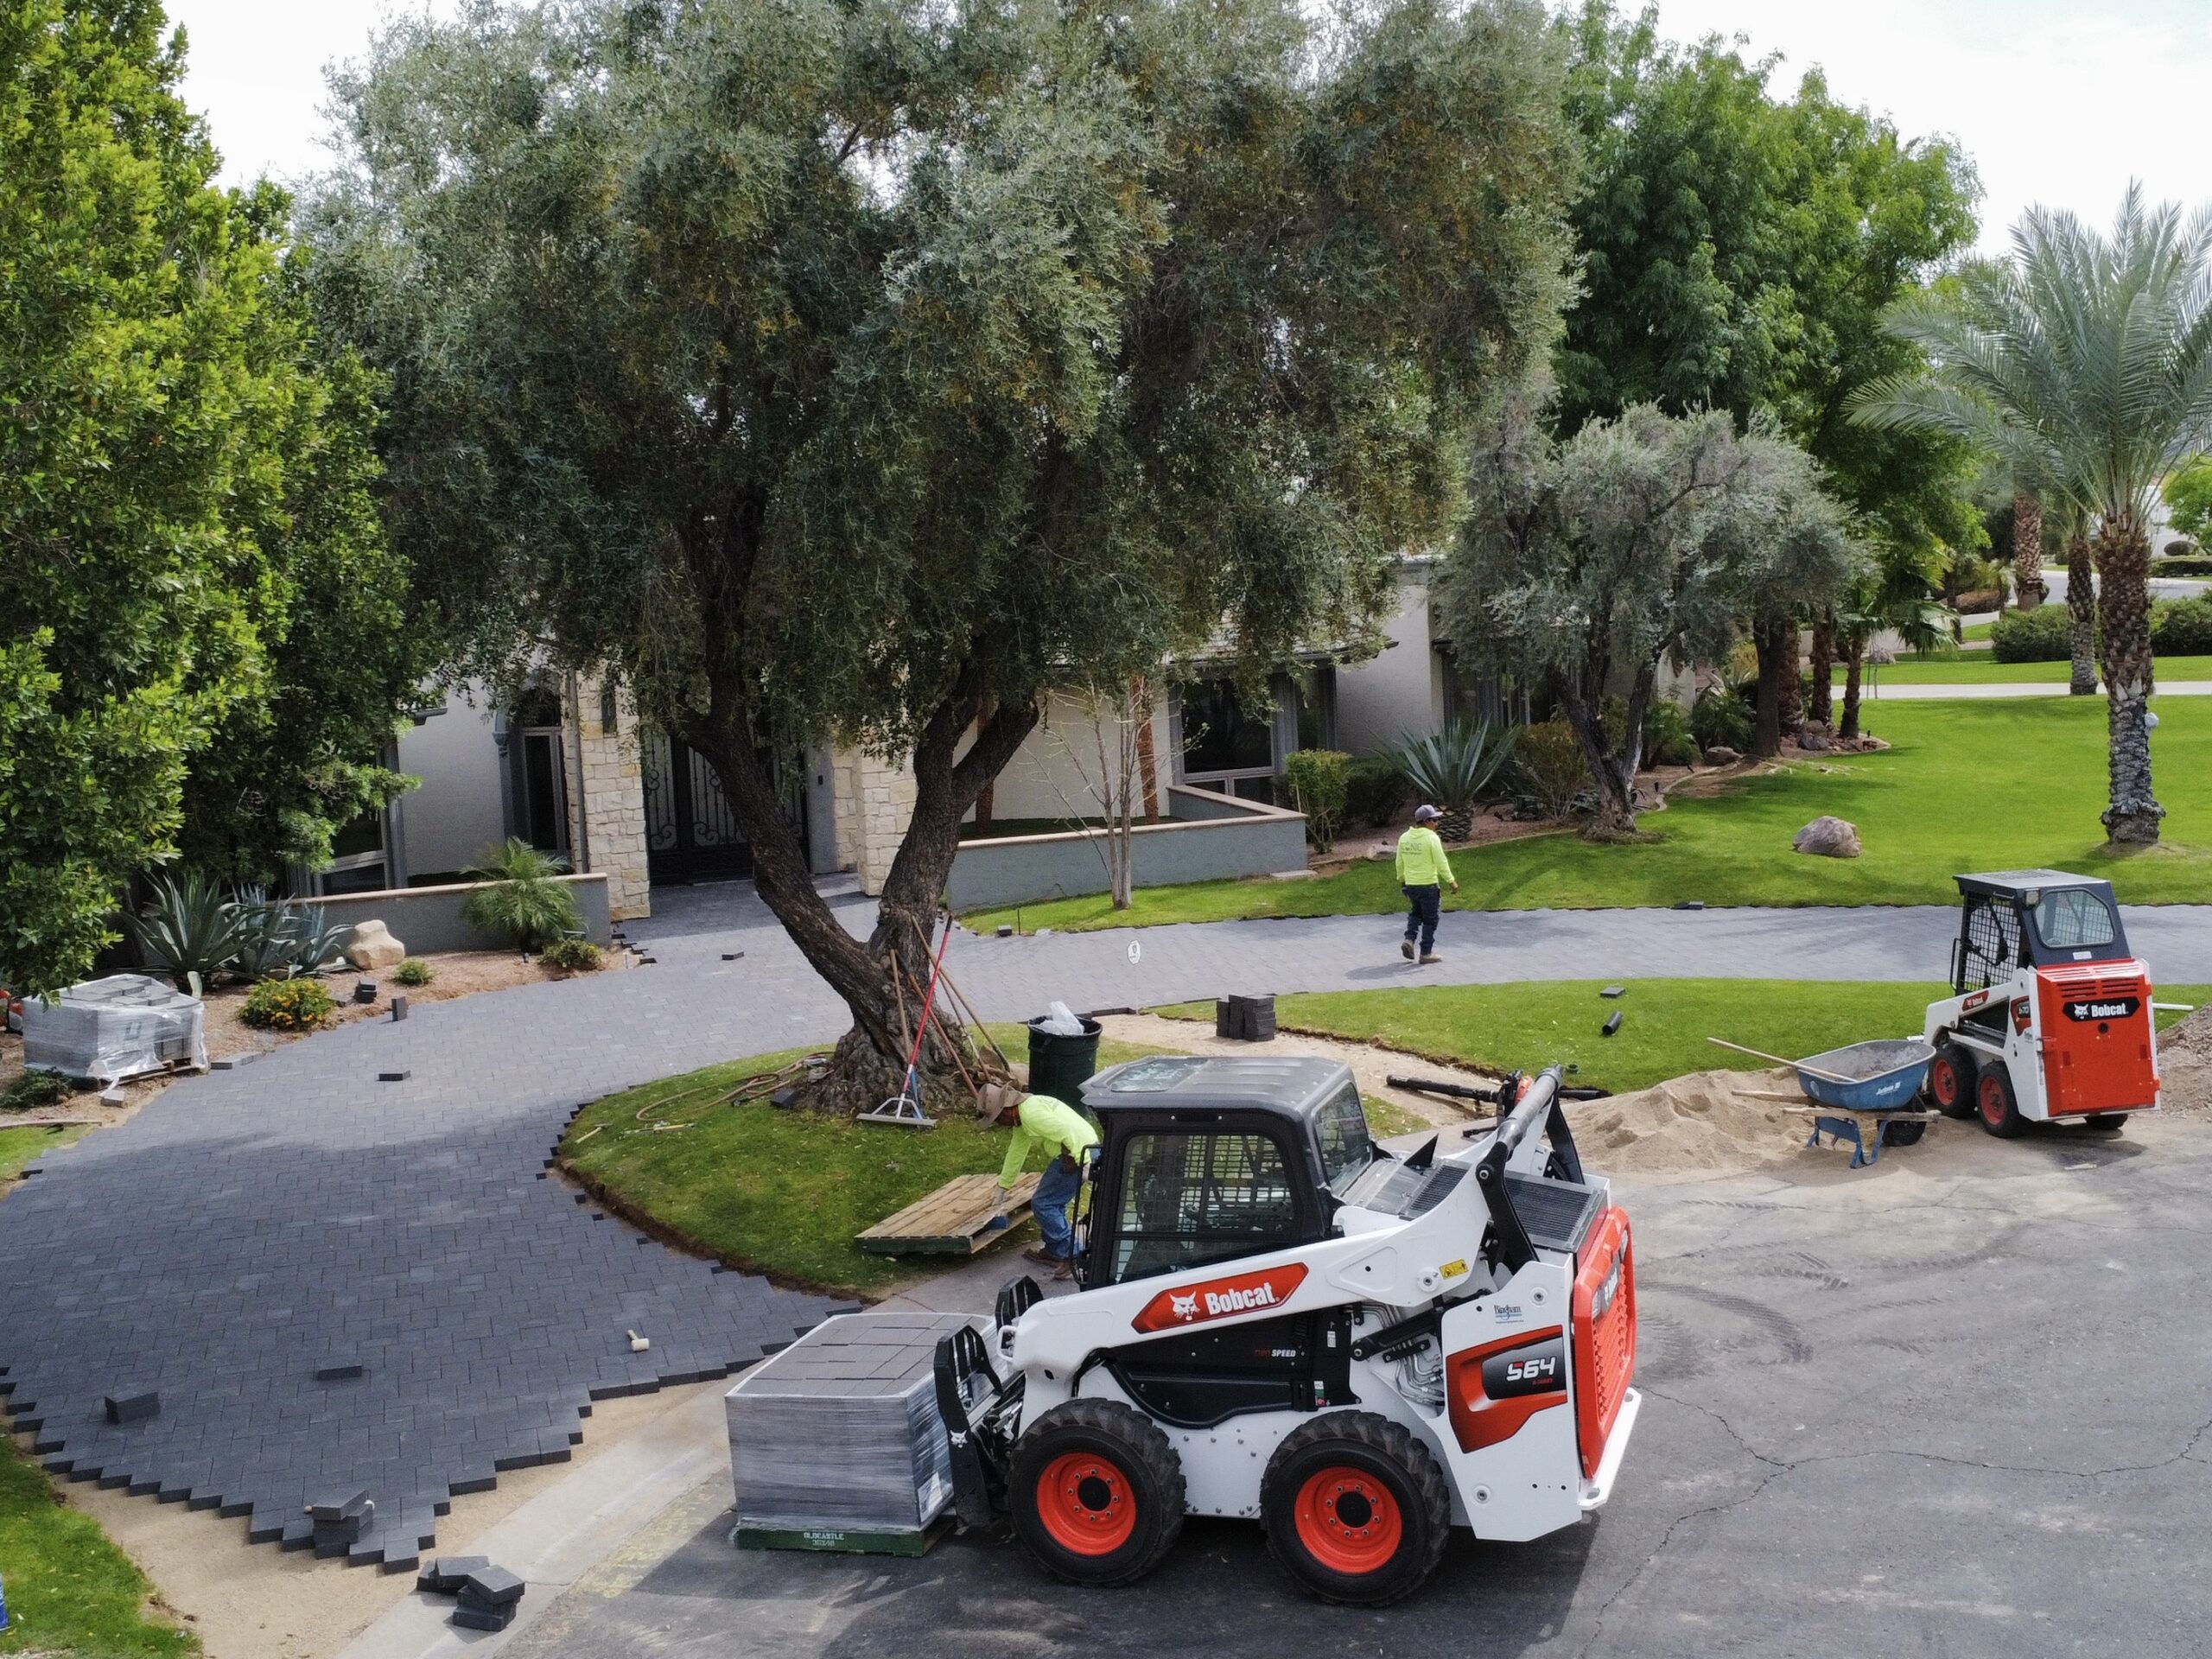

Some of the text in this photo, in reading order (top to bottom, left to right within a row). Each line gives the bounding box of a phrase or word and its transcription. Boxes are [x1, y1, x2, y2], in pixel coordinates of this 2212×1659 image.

[2091, 1003, 2126, 1018] Bobcat
[1205, 1282, 1276, 1315] Bobcat
[1271, 1349, 1296, 1357] SPEED
[1507, 1357, 1556, 1382] S64
[804, 1532, 844, 1541] OLDCASTLE
